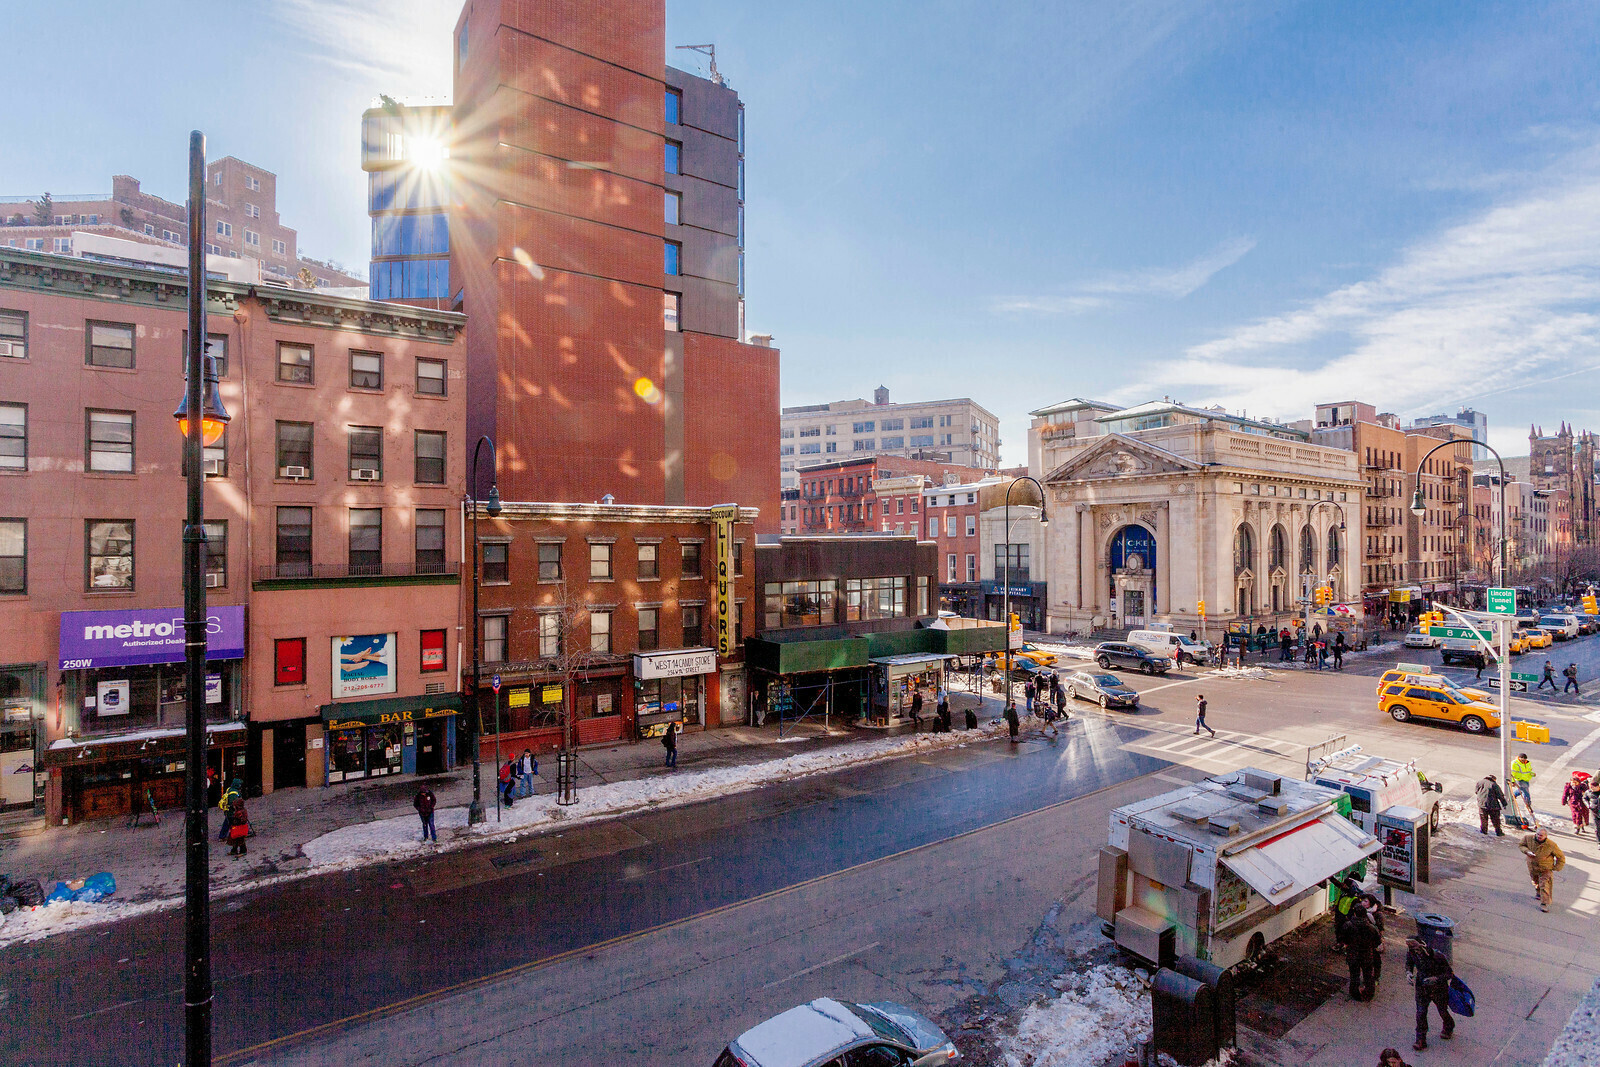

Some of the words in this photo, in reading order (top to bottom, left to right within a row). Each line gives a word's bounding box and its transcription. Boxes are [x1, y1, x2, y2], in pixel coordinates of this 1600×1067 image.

[718, 523, 728, 654] LIQUORS
[1446, 629, 1454, 637] 8
[1460, 630, 1474, 638] Av
[122, 640, 164, 648] Authorized
[62, 658, 93, 669] 250W
[654, 659, 671, 670] WEST
[679, 657, 694, 668] CANDY
[695, 655, 711, 666] STORE
[381, 710, 413, 723] BAR
